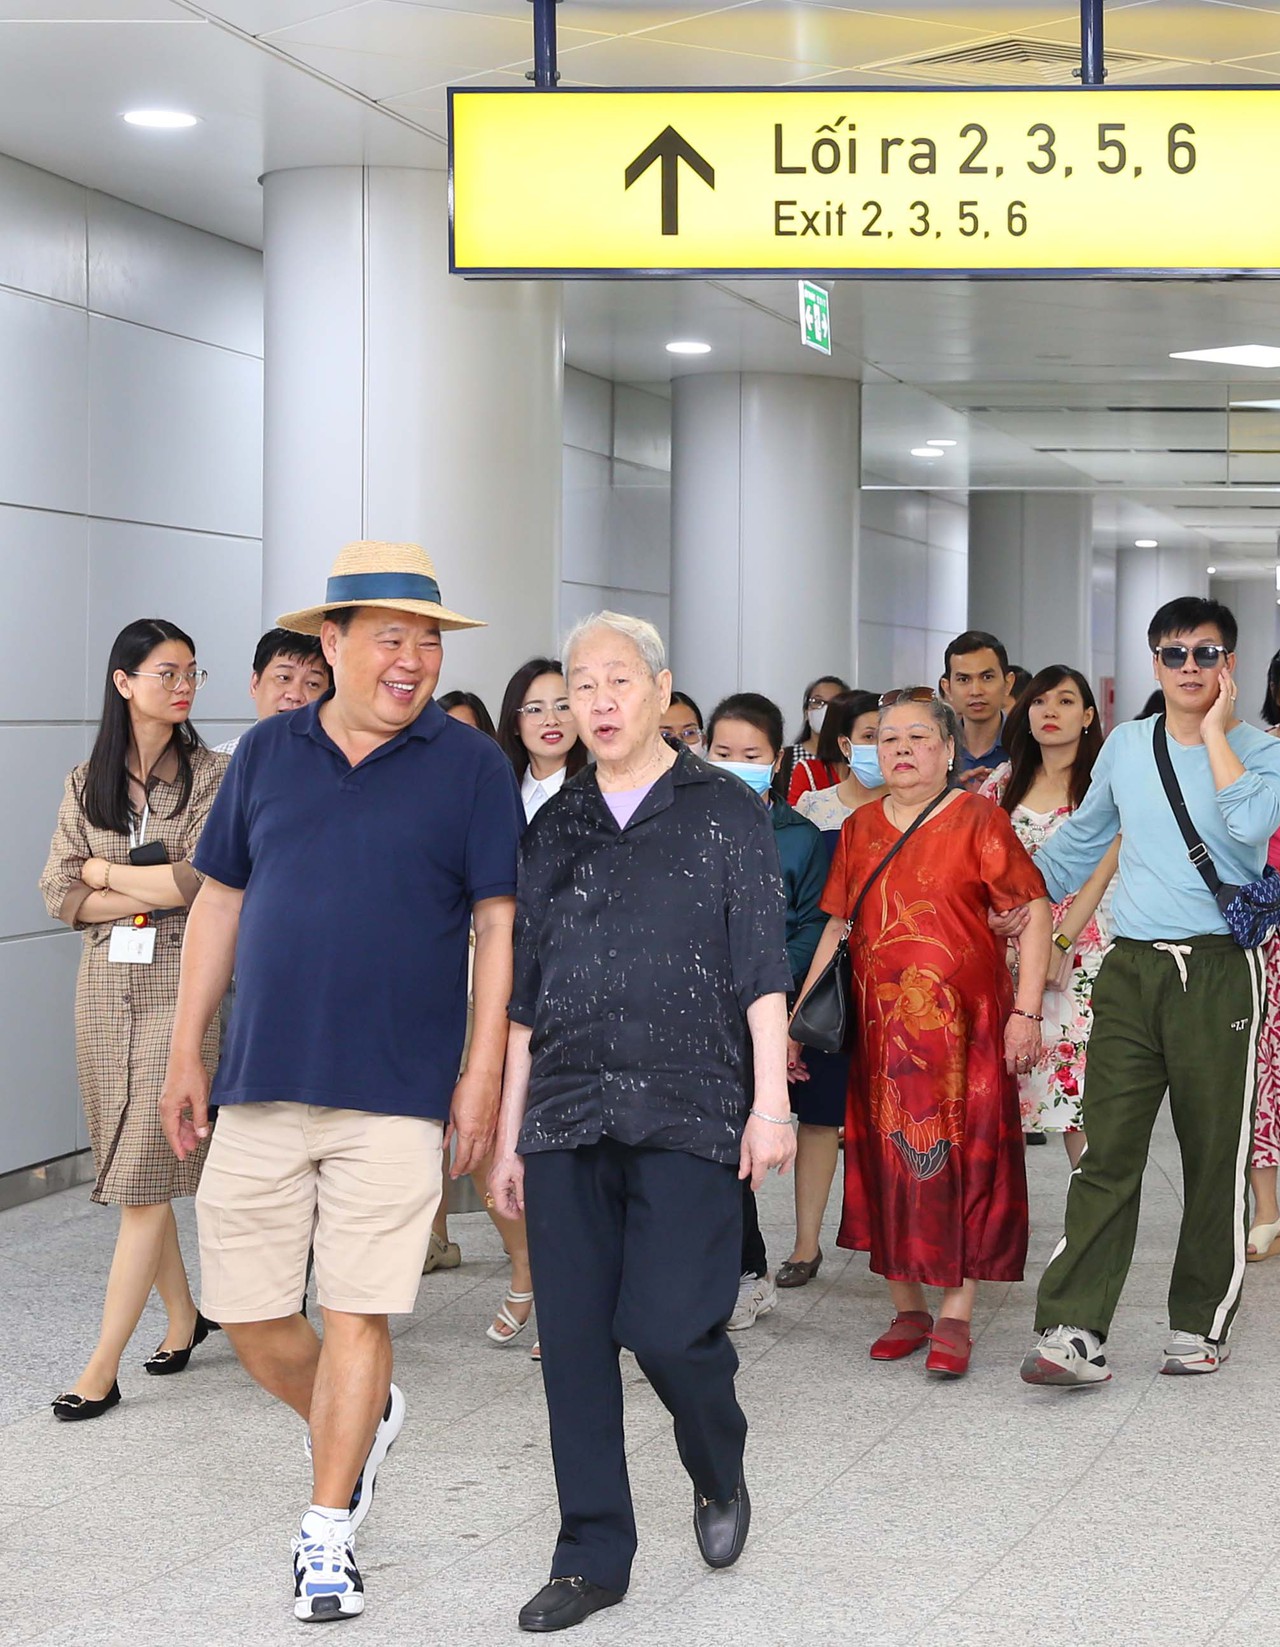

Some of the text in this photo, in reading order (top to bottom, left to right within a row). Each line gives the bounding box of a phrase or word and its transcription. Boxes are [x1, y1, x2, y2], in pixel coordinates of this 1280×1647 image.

[774, 115, 1196, 178] Lối ra 2, 3, 5, 6
[774, 200, 1027, 239] Exit 2, 3, 5, 6
